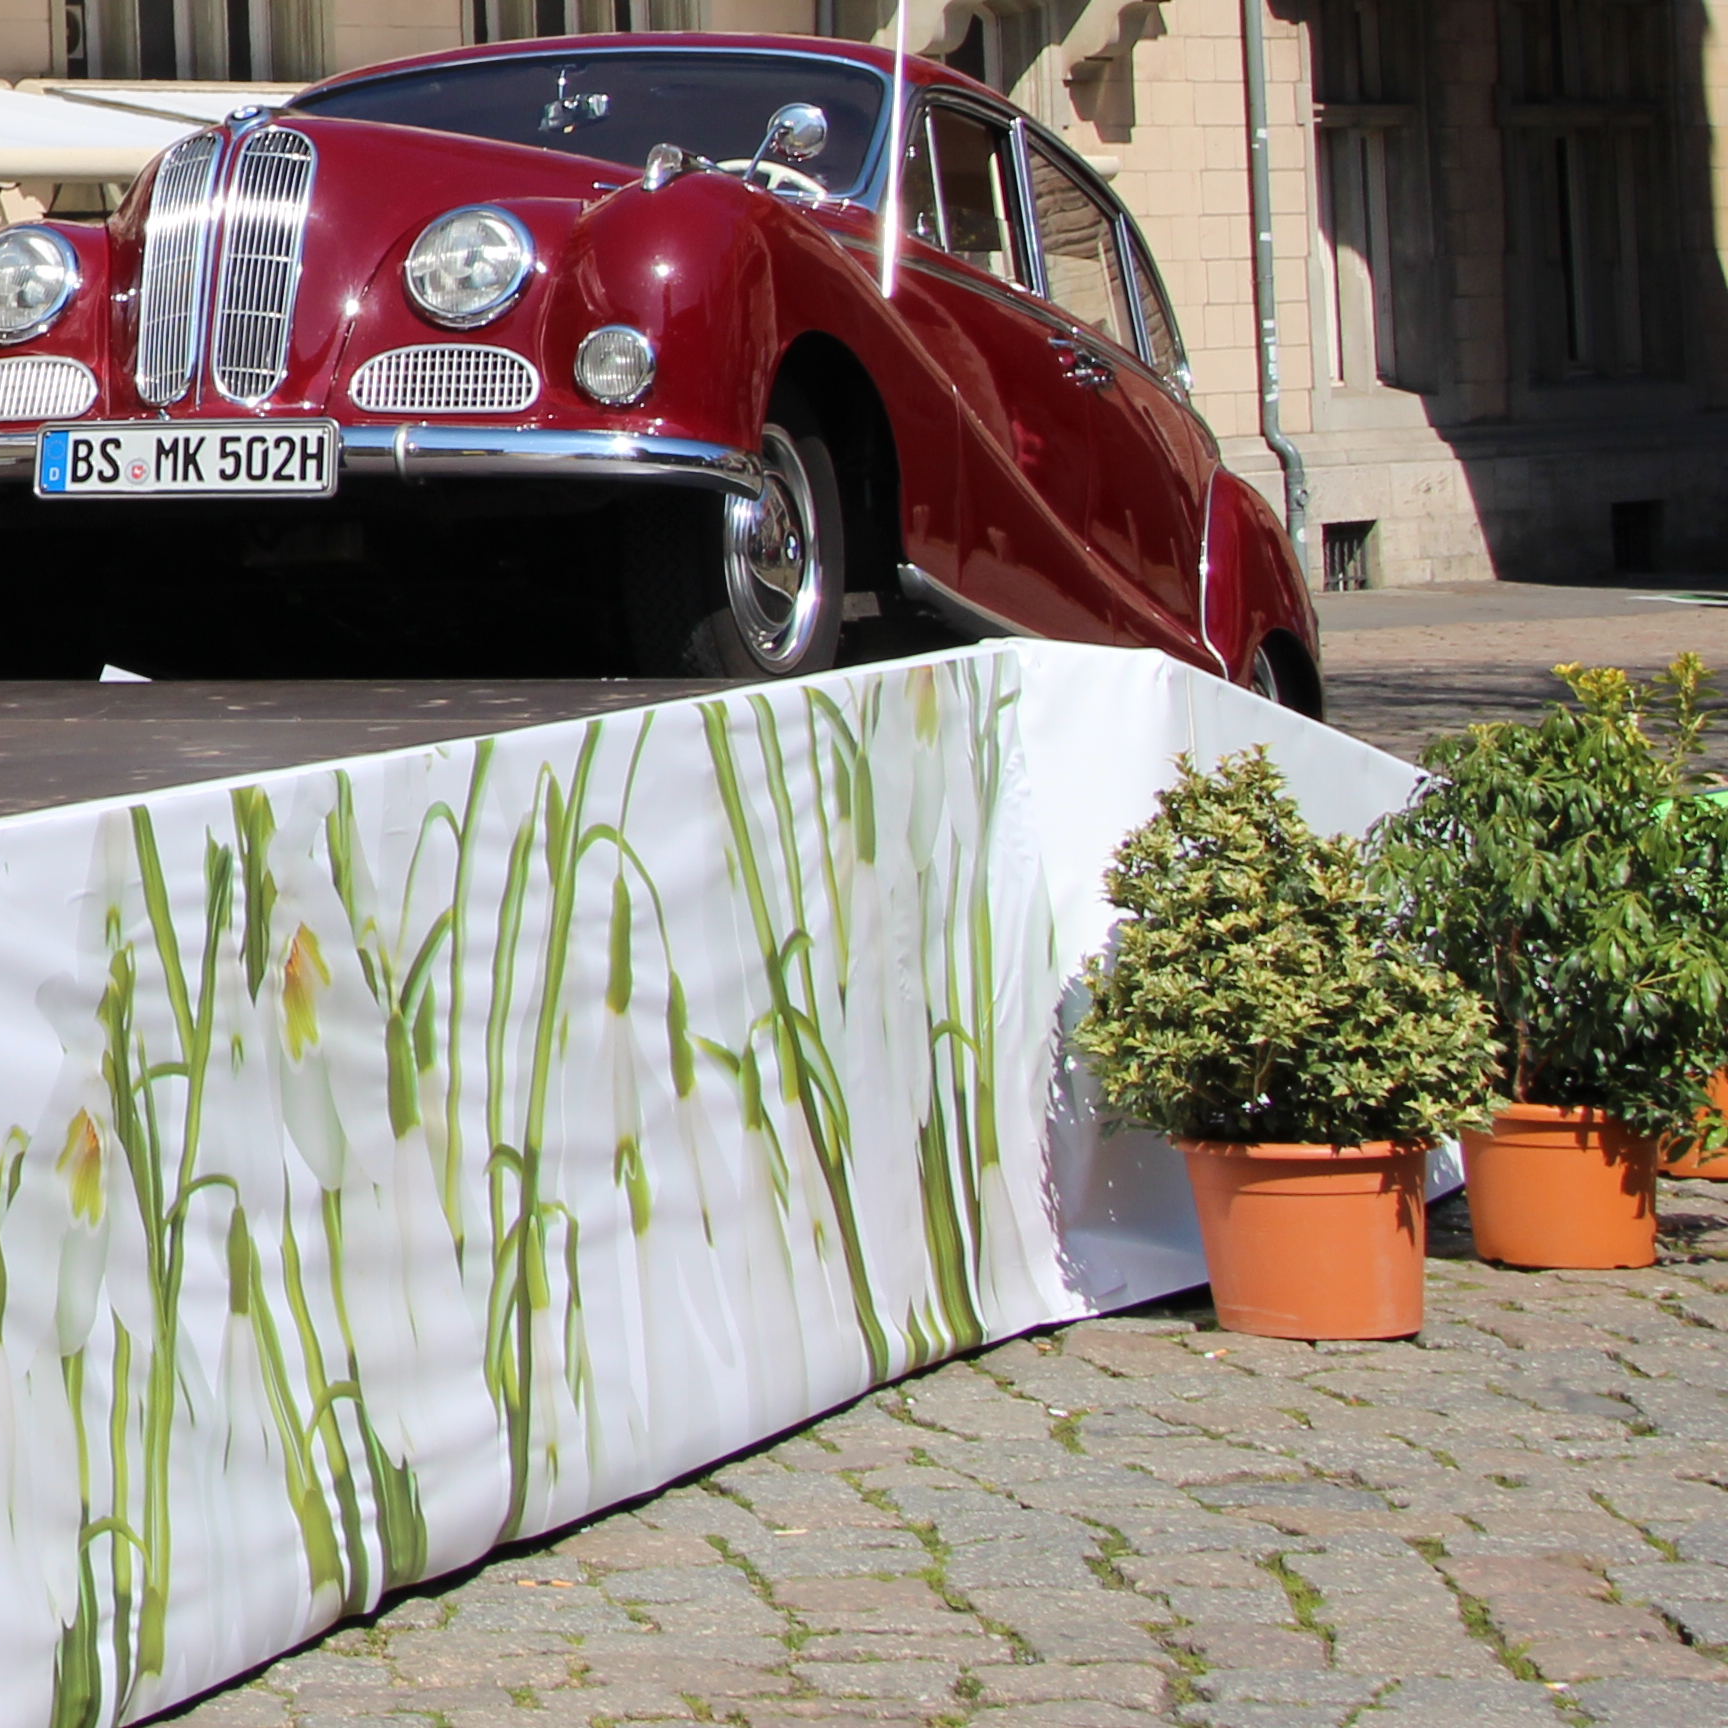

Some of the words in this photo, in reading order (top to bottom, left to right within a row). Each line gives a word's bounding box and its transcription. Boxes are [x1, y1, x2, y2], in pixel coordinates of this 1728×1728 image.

[48, 468, 60, 482] D
[71, 439, 122, 484] BS
[155, 436, 207, 483] MK
[218, 436, 326, 482] 502H
